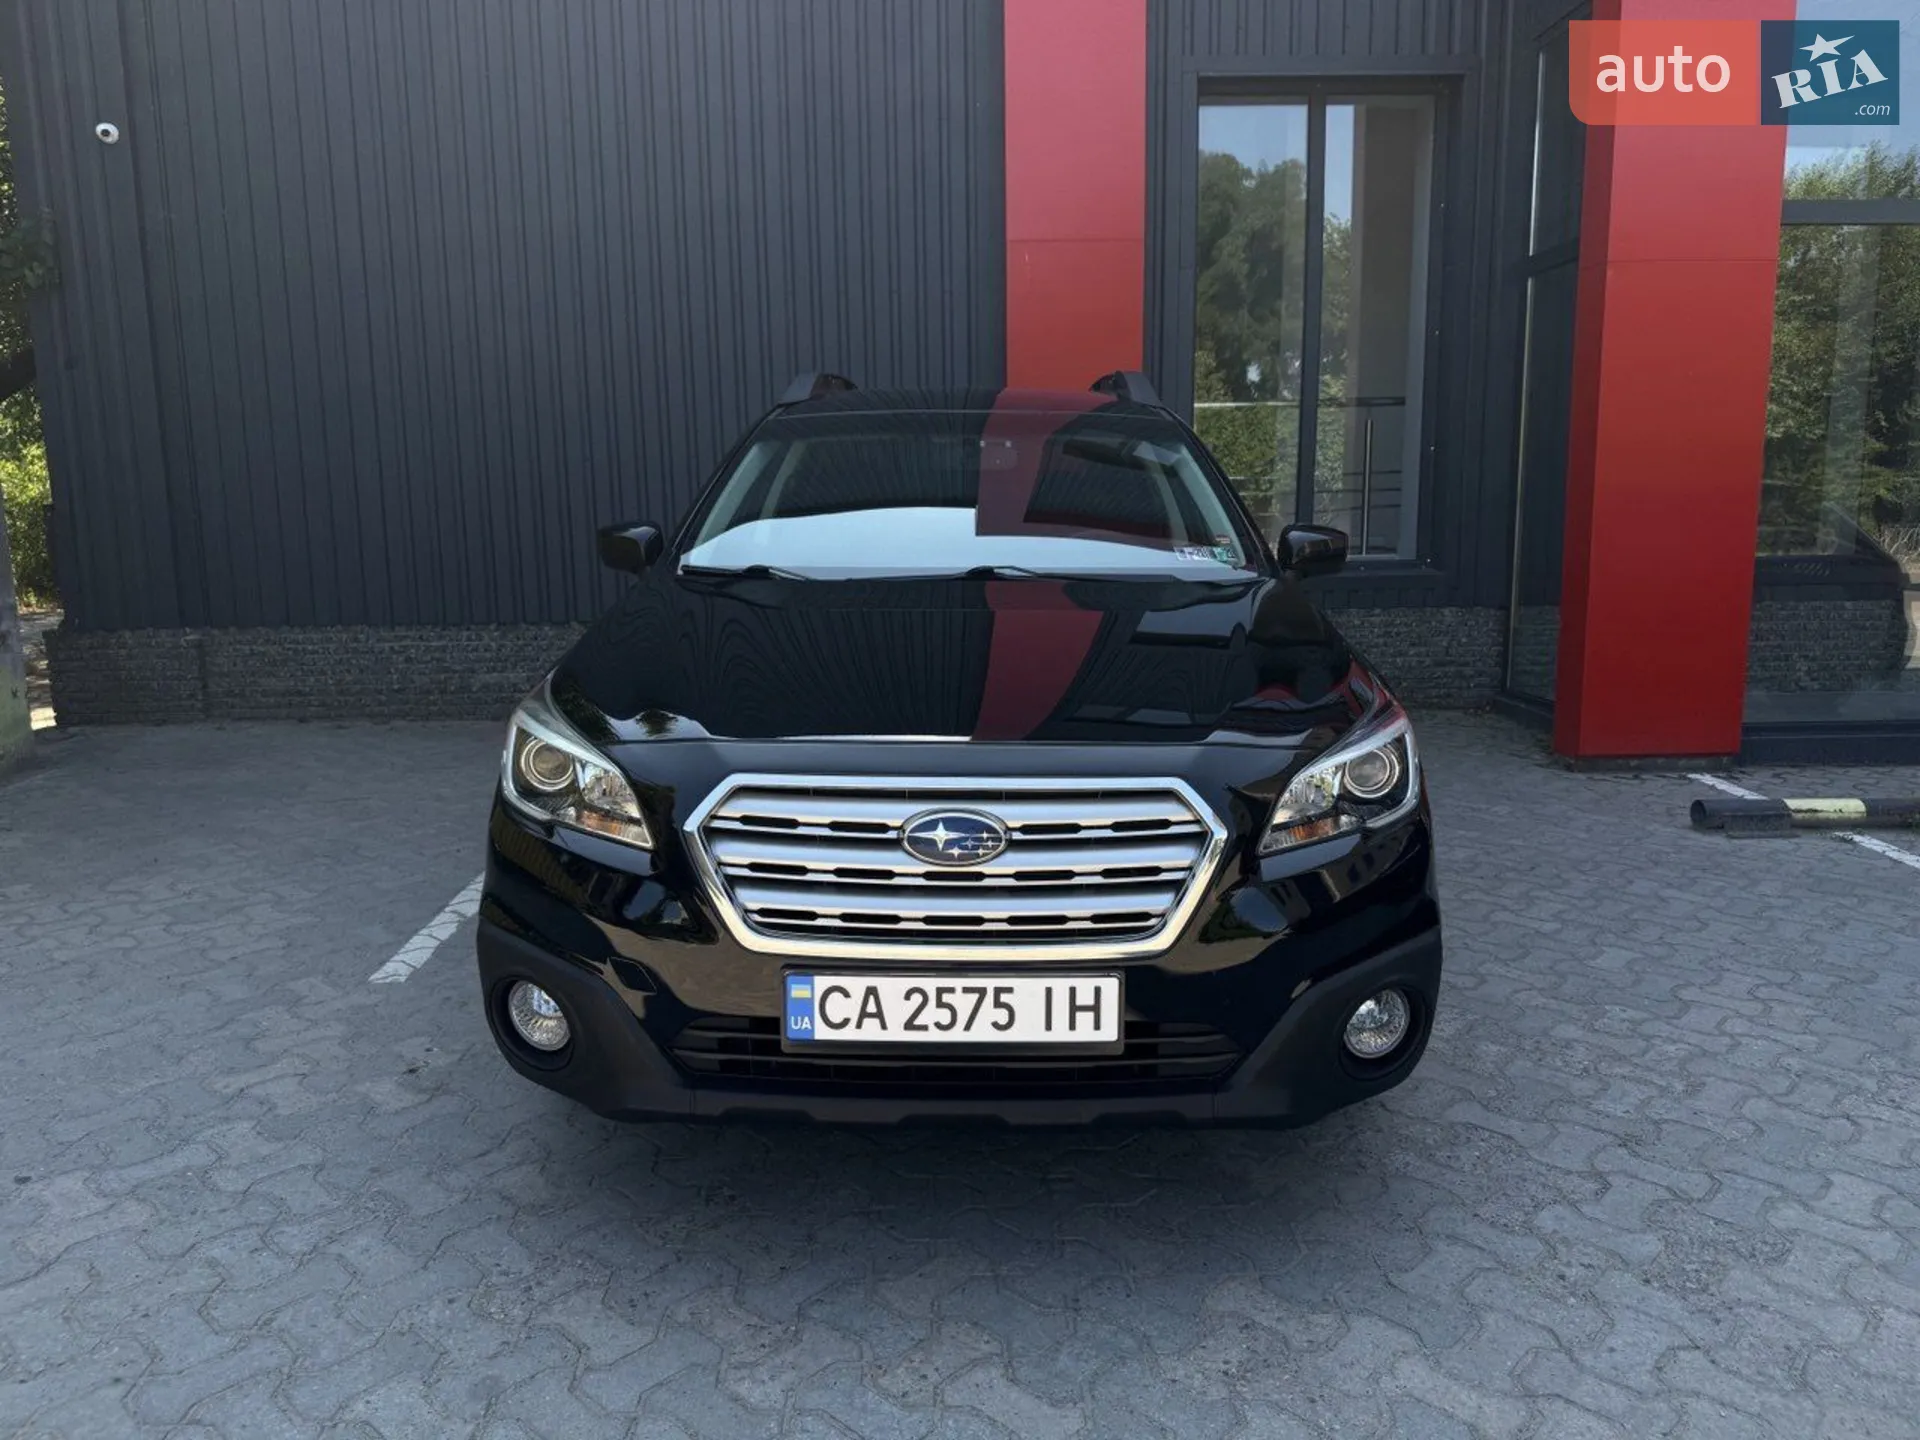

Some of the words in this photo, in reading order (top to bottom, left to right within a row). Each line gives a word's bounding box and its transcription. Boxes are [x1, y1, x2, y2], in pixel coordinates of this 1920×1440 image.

[818, 985, 888, 1031] CA
[903, 986, 1016, 1032] 2575
[1045, 986, 1102, 1032] IH
[791, 1017, 812, 1031] UA
